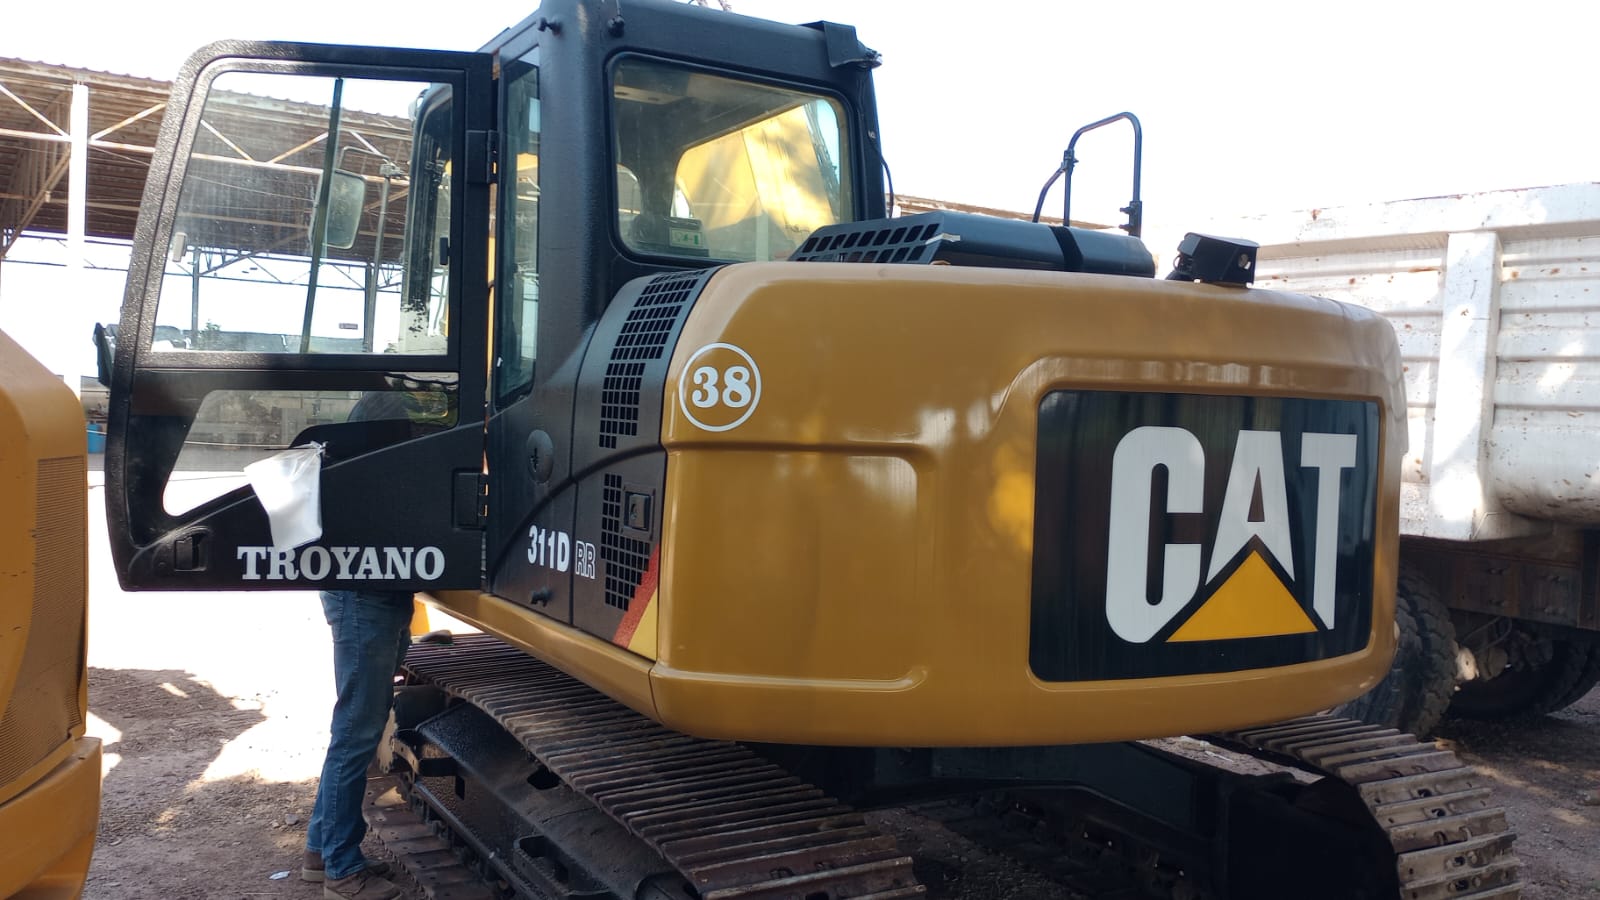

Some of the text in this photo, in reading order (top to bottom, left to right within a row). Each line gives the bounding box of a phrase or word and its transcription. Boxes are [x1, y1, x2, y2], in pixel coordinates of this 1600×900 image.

[692, 366, 752, 408] 38
[527, 524, 596, 579] 311D RR
[1105, 425, 1358, 643] CAT
[237, 546, 446, 580] TROYANO
